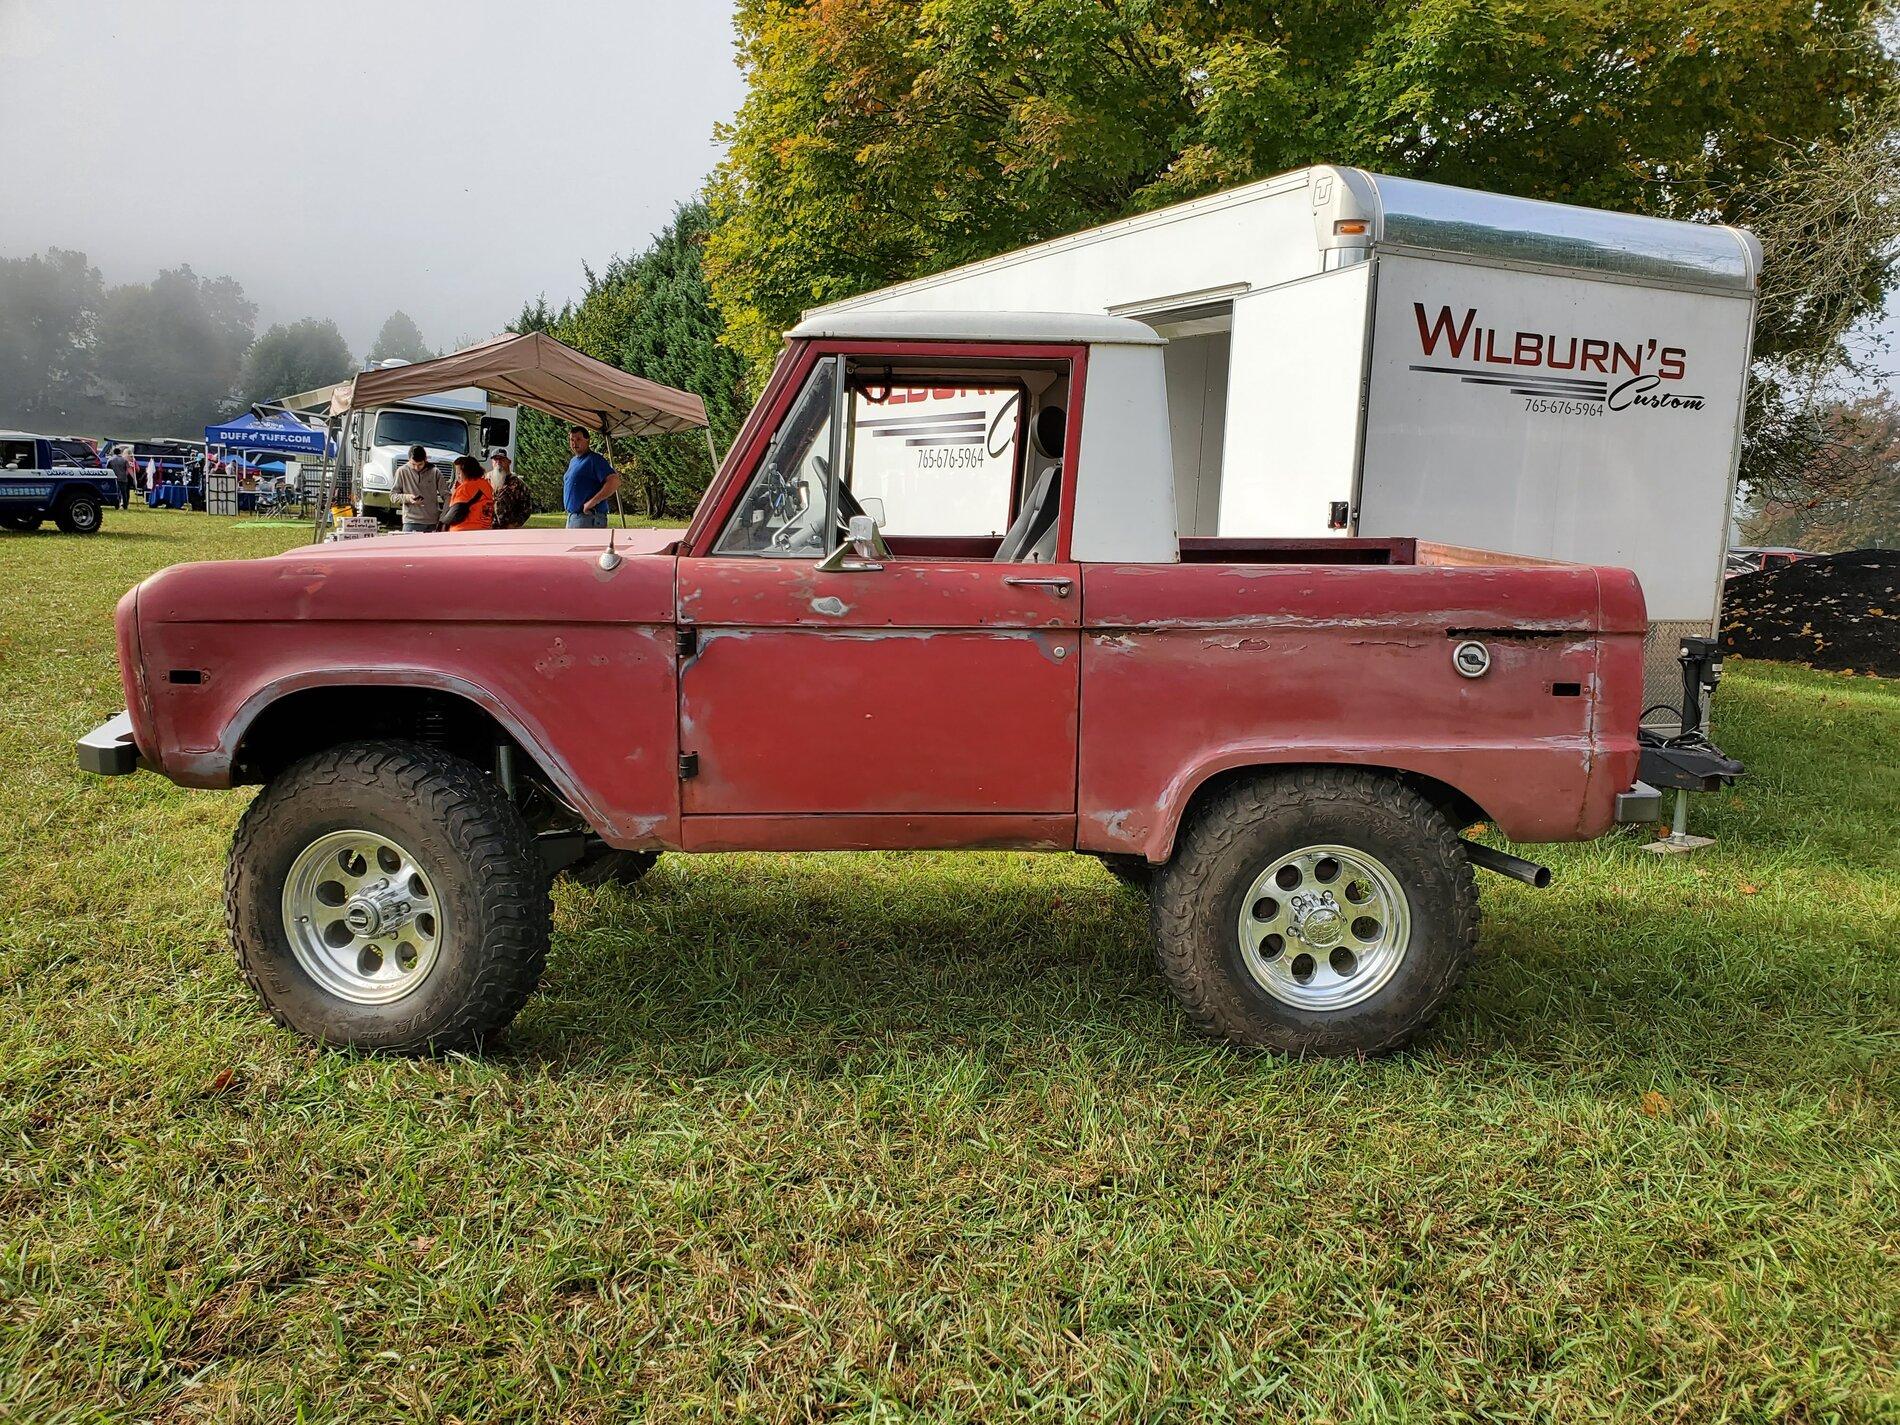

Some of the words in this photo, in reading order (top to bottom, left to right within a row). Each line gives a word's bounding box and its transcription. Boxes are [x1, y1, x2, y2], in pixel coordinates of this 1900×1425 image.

[1608, 374, 1705, 412] Custom
[1525, 398, 1604, 417] 765-676-5964
[220, 431, 248, 440] DUFF
[260, 433, 311, 443] TUFF.COM
[918, 448, 984, 469] 765-676-5964
